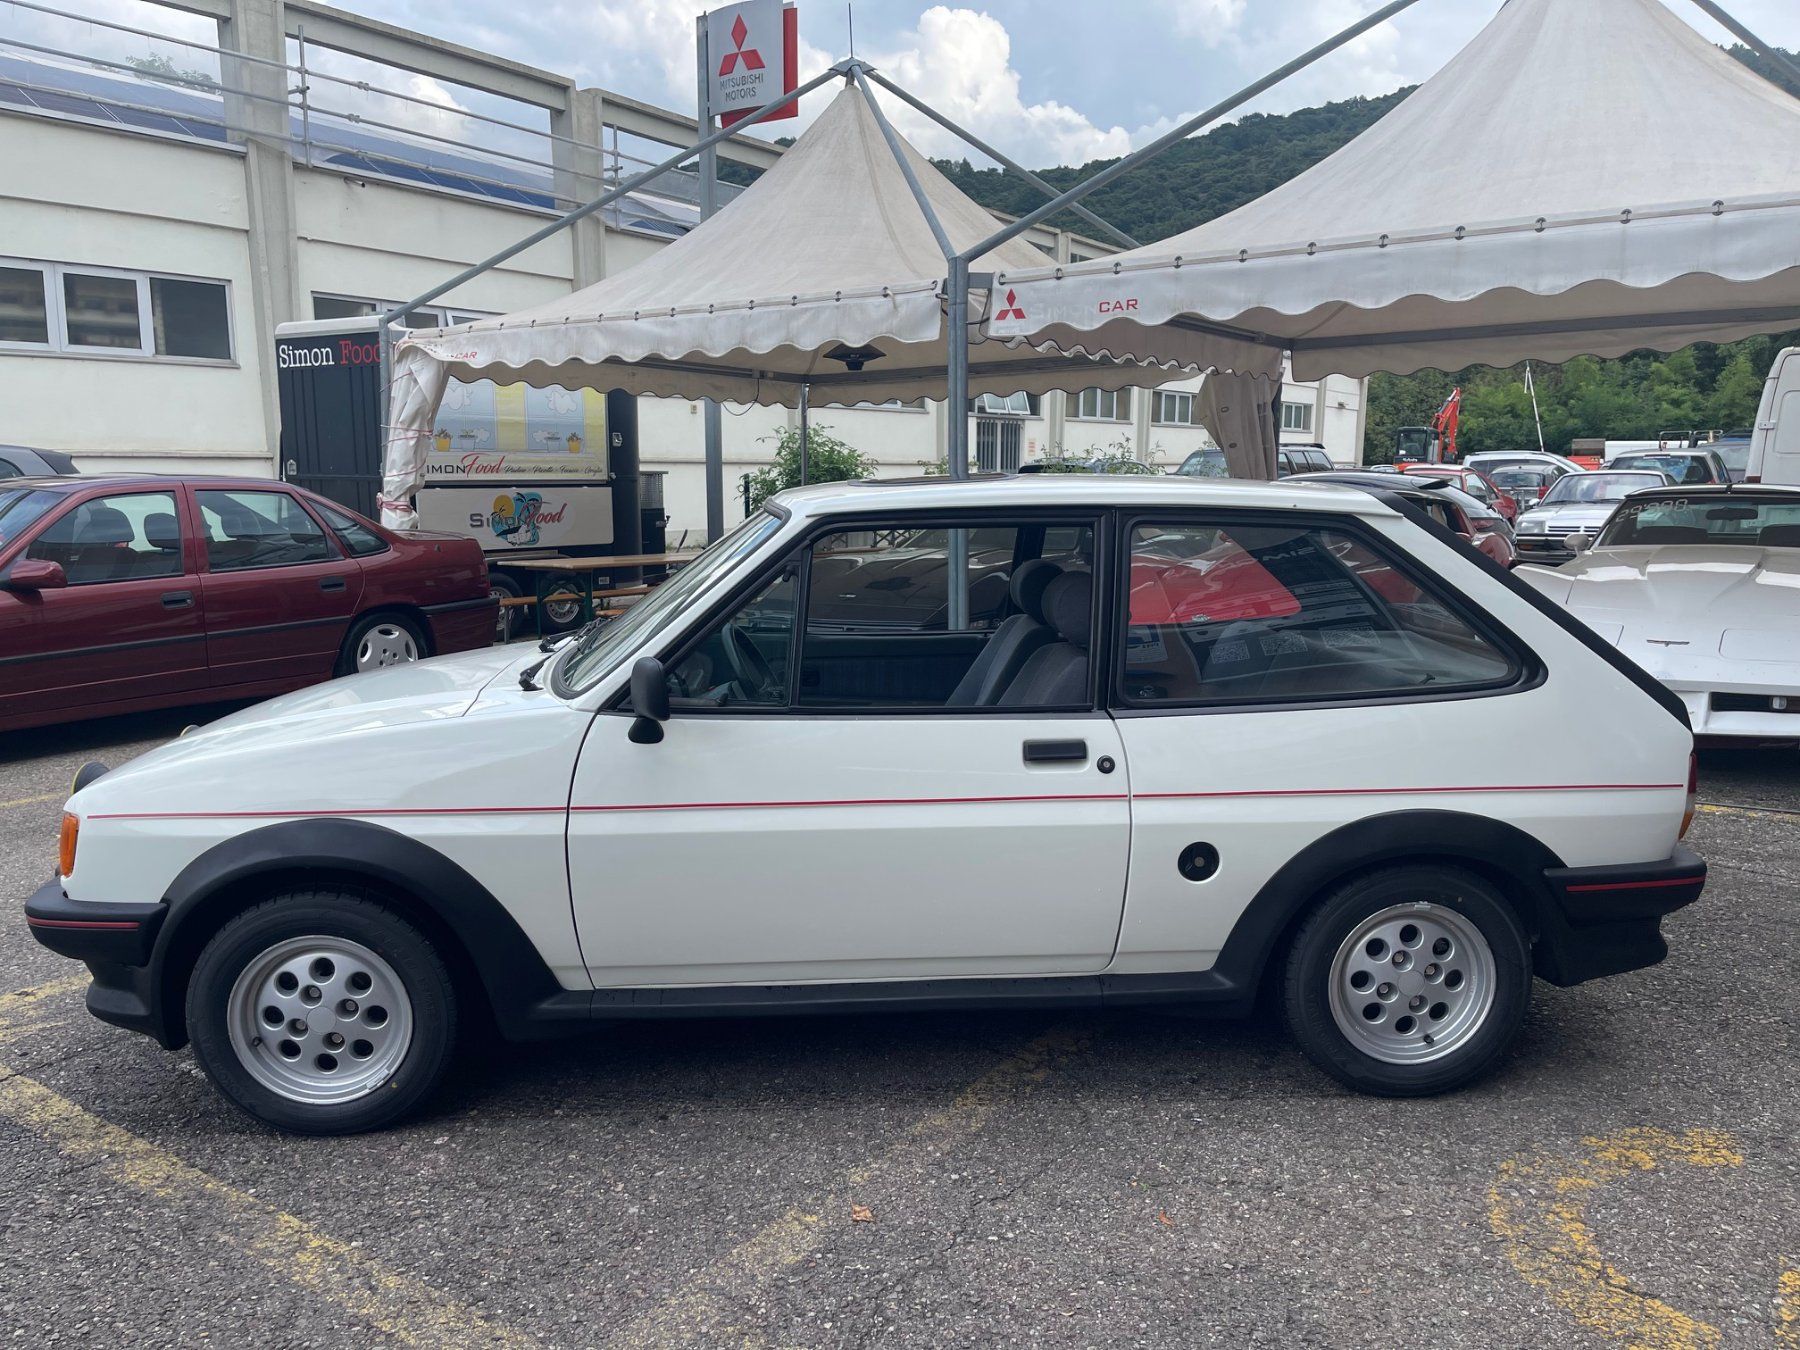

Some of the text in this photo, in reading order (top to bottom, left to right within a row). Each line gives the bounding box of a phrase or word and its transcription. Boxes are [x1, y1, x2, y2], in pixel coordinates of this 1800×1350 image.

[720, 73, 764, 91] MITSUBISHI
[725, 87, 757, 102] MOTORS
[1099, 298, 1138, 313] CAR
[279, 344, 335, 368] Simon
[426, 464, 466, 475] IMON
[460, 452, 506, 478] Food
